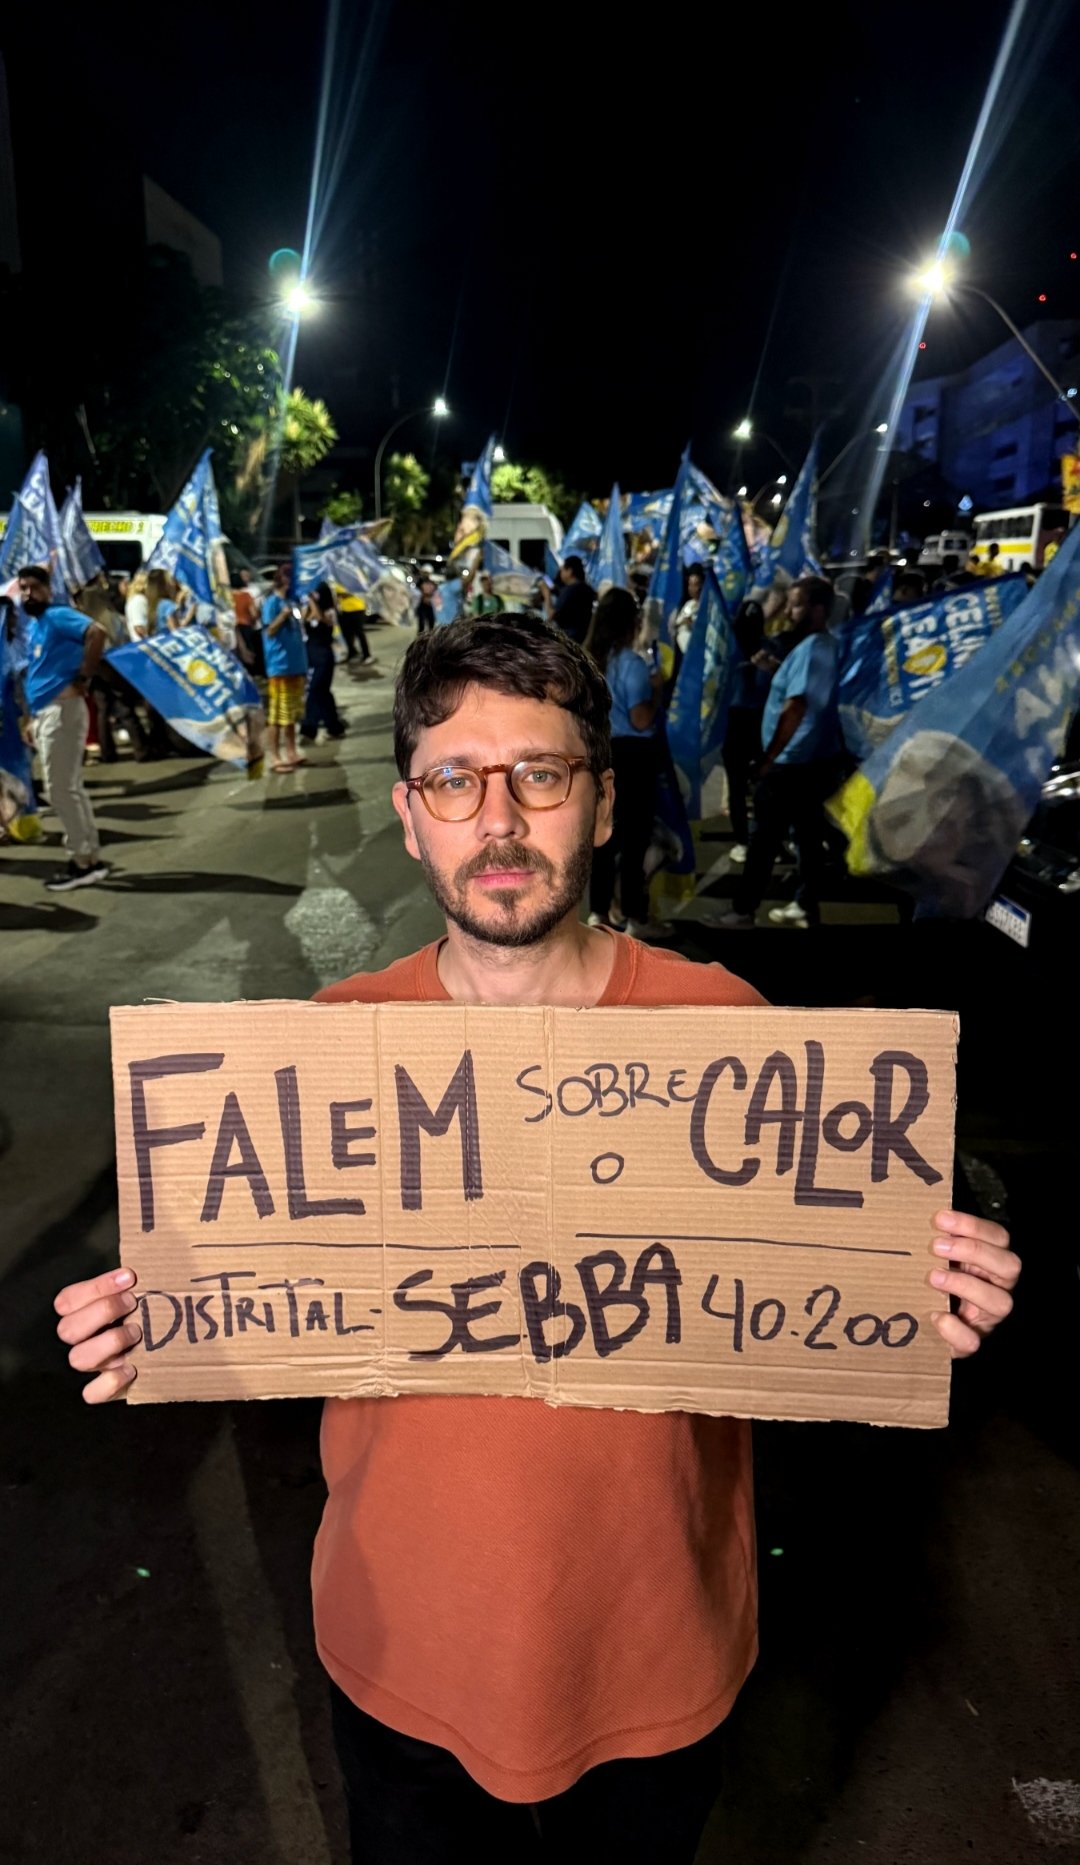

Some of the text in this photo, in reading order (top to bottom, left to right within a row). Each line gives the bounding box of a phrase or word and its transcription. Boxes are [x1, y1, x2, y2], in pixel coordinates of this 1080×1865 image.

[204, 678, 234, 708] 11
[129, 1049, 485, 1233] FALEM
[515, 1062, 697, 1124] SOBRE
[690, 1040, 945, 1208] CALOR
[393, 1242, 683, 1364] SEBBA
[701, 1274, 920, 1353] 40.200
